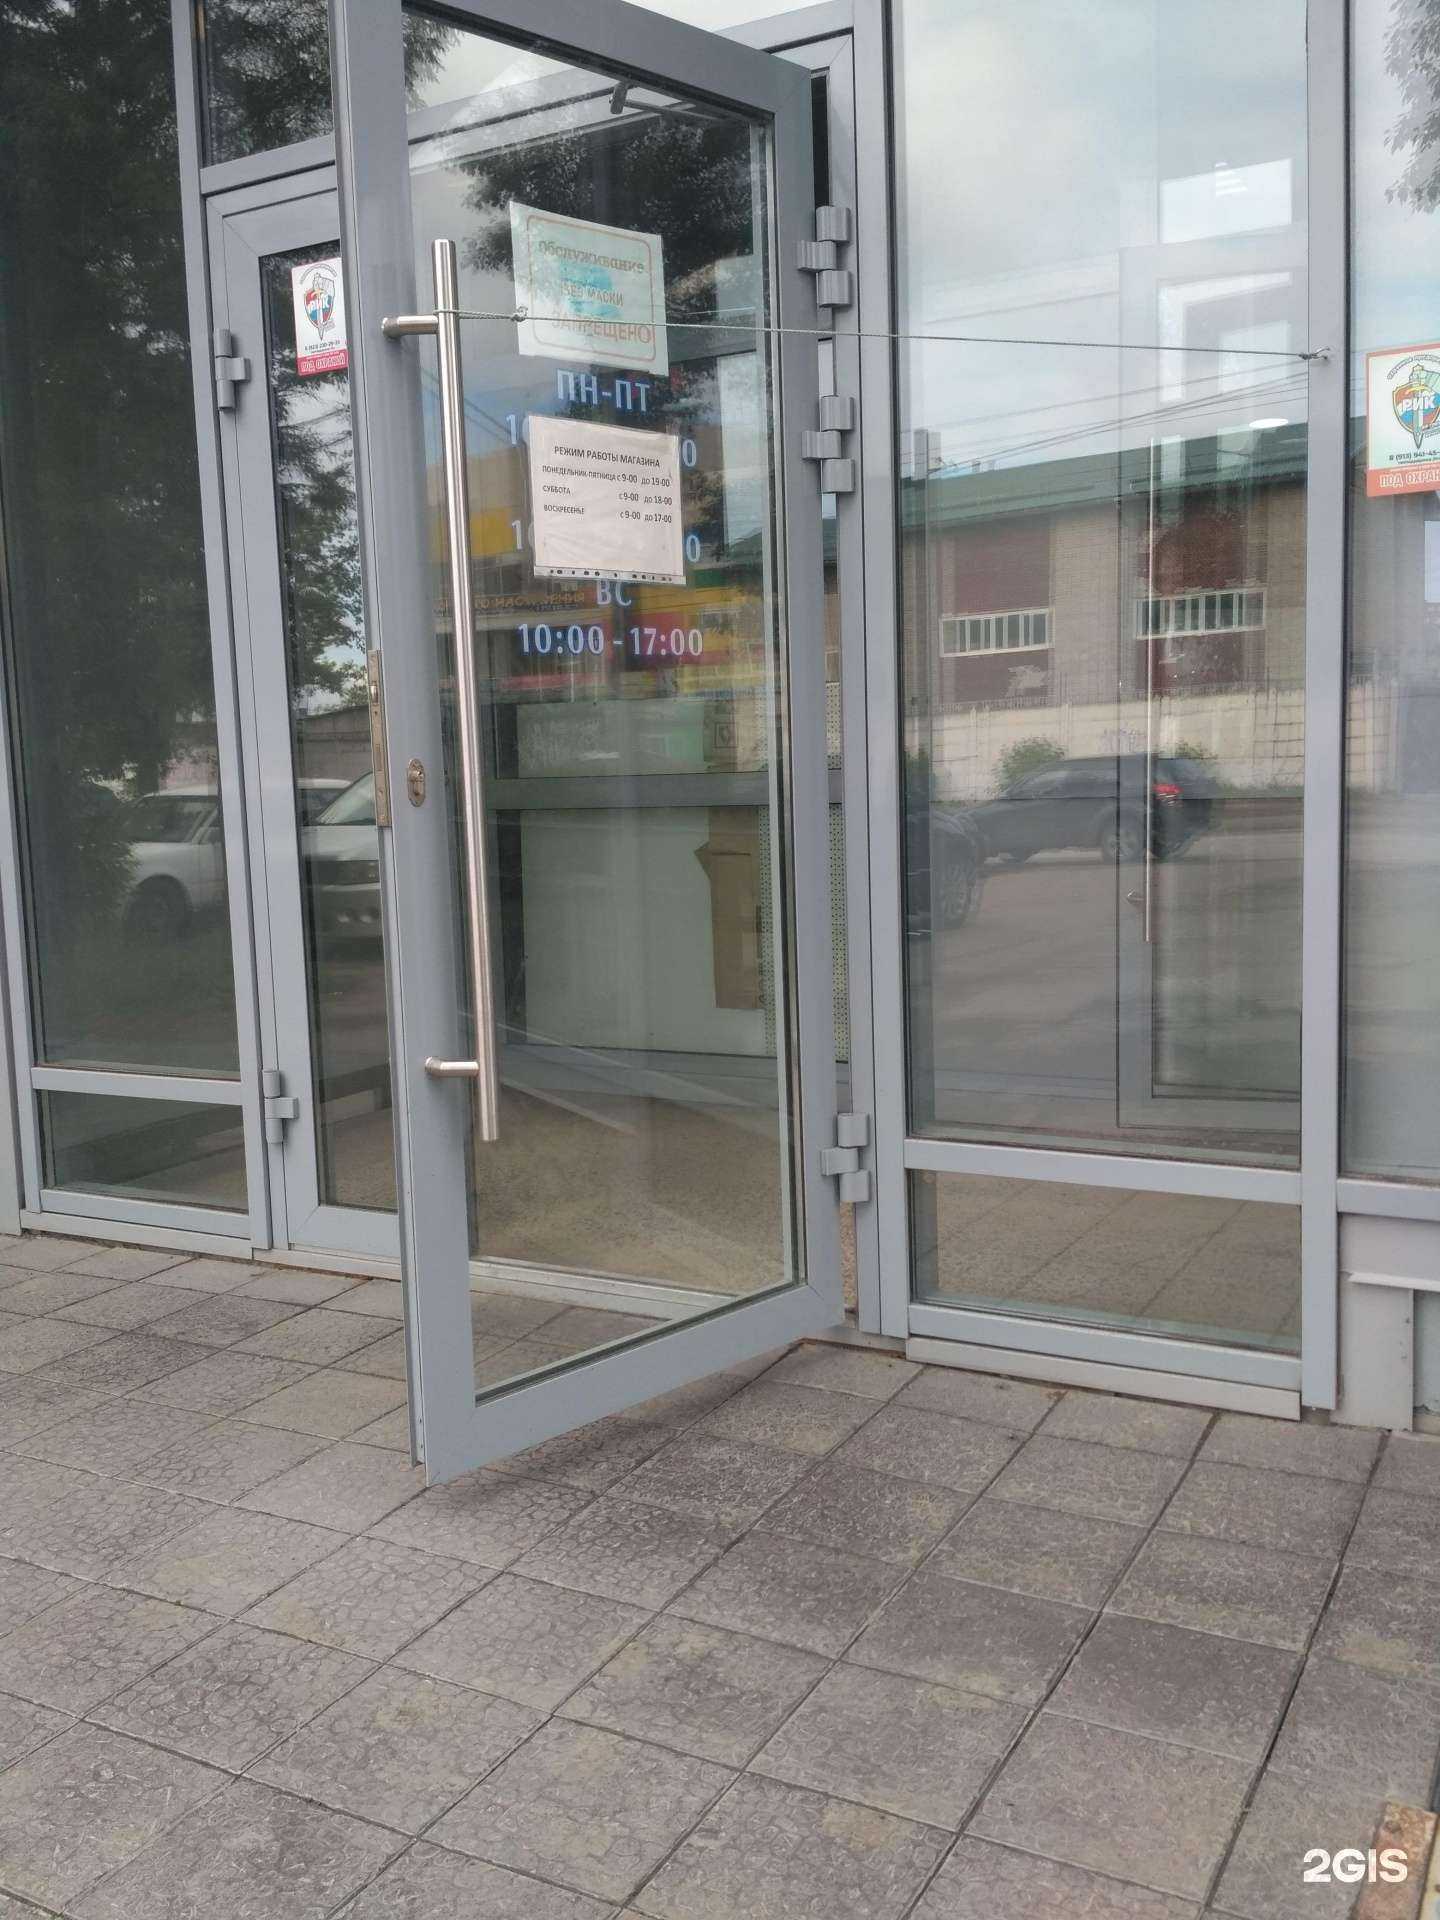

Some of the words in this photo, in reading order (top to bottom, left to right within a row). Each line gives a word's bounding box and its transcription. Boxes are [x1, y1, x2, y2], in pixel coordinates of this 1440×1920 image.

[552, 309, 651, 343] ЗАПРЕЩЕНО
[557, 369, 650, 412] ПН-ПТ
[1402, 395, 1435, 412] РИК
[554, 446, 585, 459] РЕЖИМ
[586, 450, 619, 462] РАБОТЫ
[620, 454, 660, 468] МАГАЗИНА
[621, 473, 638, 483] 9-00
[1380, 474, 1403, 487] ПОД
[542, 485, 571, 495] СУББОТА
[623, 492, 639, 502] 9-00
[625, 510, 641, 520] 9-00
[654, 513, 672, 523] 17-00
[596, 580, 632, 607] ВС
